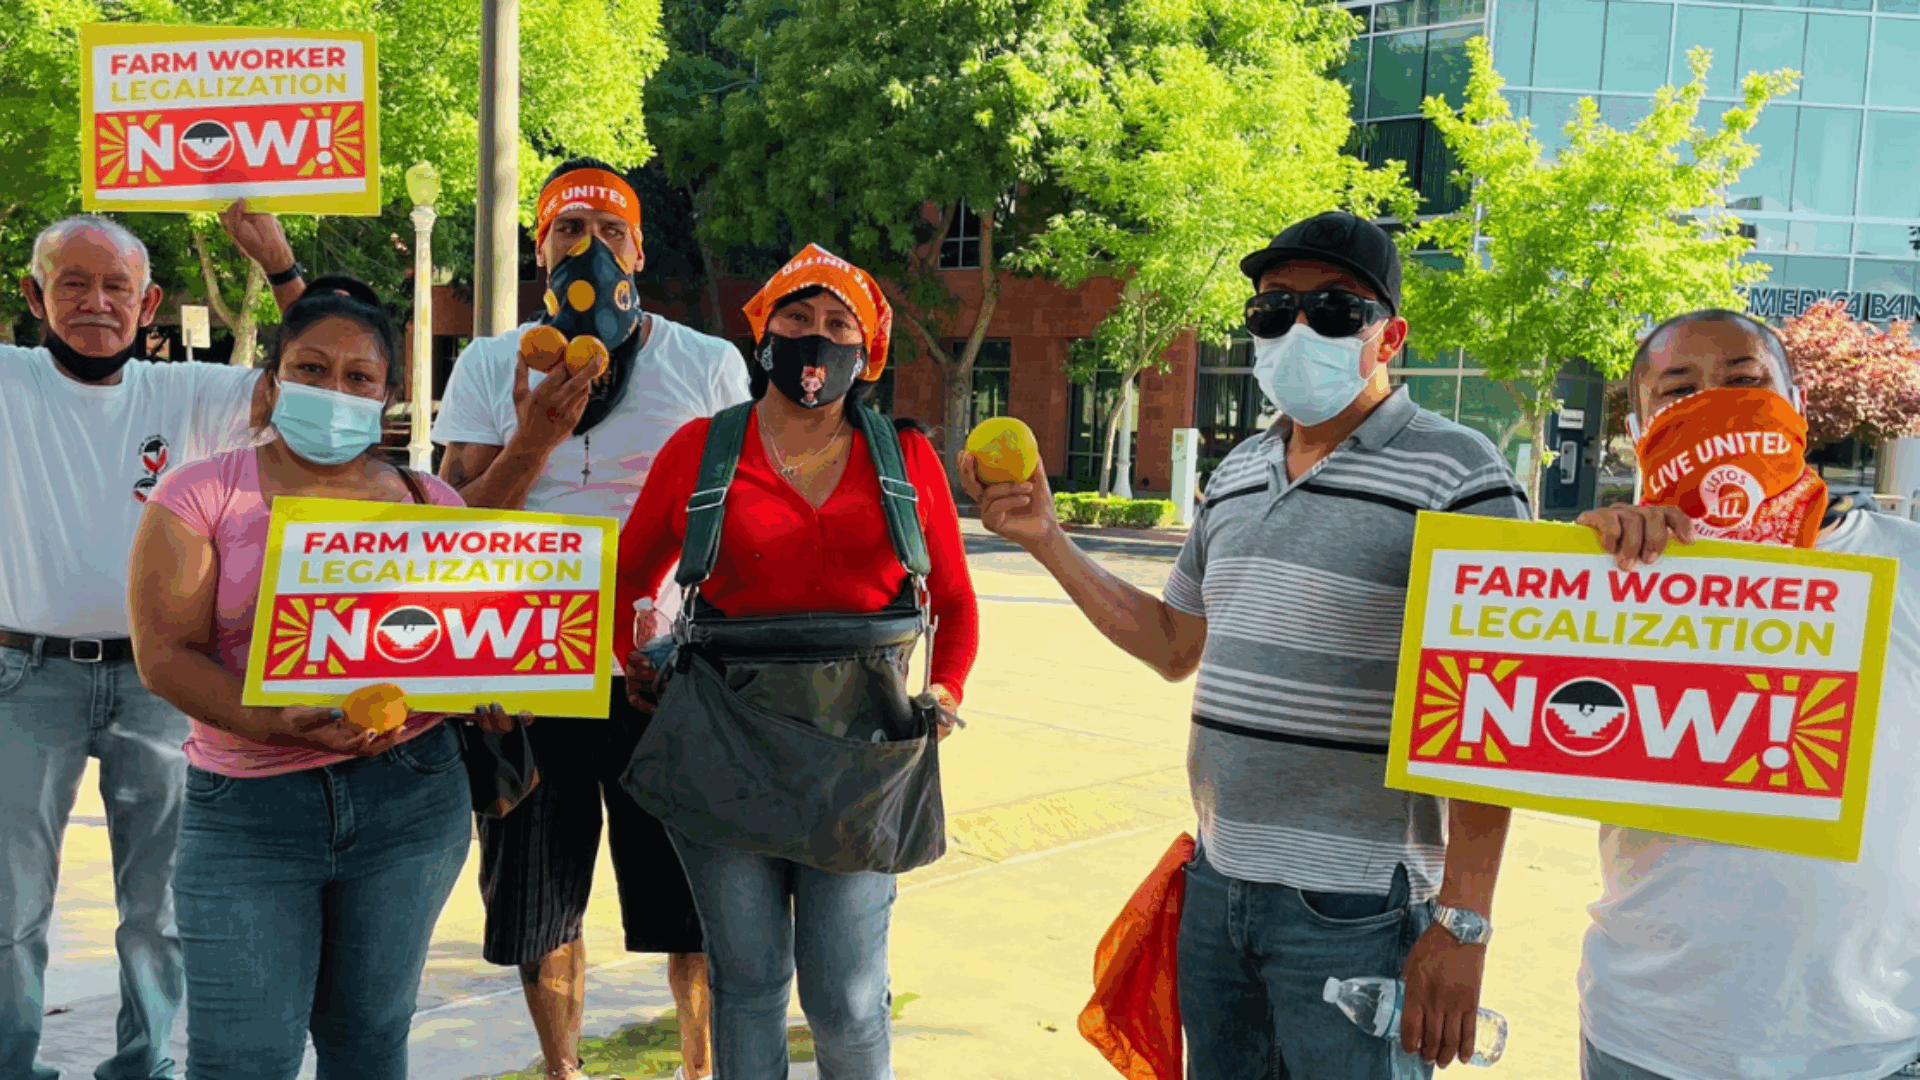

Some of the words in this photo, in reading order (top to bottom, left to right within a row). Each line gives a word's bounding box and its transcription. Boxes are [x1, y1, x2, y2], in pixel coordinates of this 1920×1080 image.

[110, 52, 198, 75] FARM
[207, 46, 347, 72] WORKER
[110, 72, 347, 102] LEGALIZATION
[127, 119, 333, 172] NOW!
[561, 185, 627, 208] UNITED
[1649, 450, 1695, 495] LIVE
[1695, 431, 1792, 464] UNITED
[1704, 468, 1748, 494] LISTOS
[303, 531, 409, 555] FARM
[421, 530, 583, 554] WORKER
[298, 559, 582, 584] LEGALIZATION
[1454, 563, 1590, 601] FARM
[1607, 570, 1840, 613] WORKER
[307, 605, 560, 663] NOW!
[1448, 603, 1836, 658] LEGALIZATION
[1459, 672, 1797, 770] NOW!
